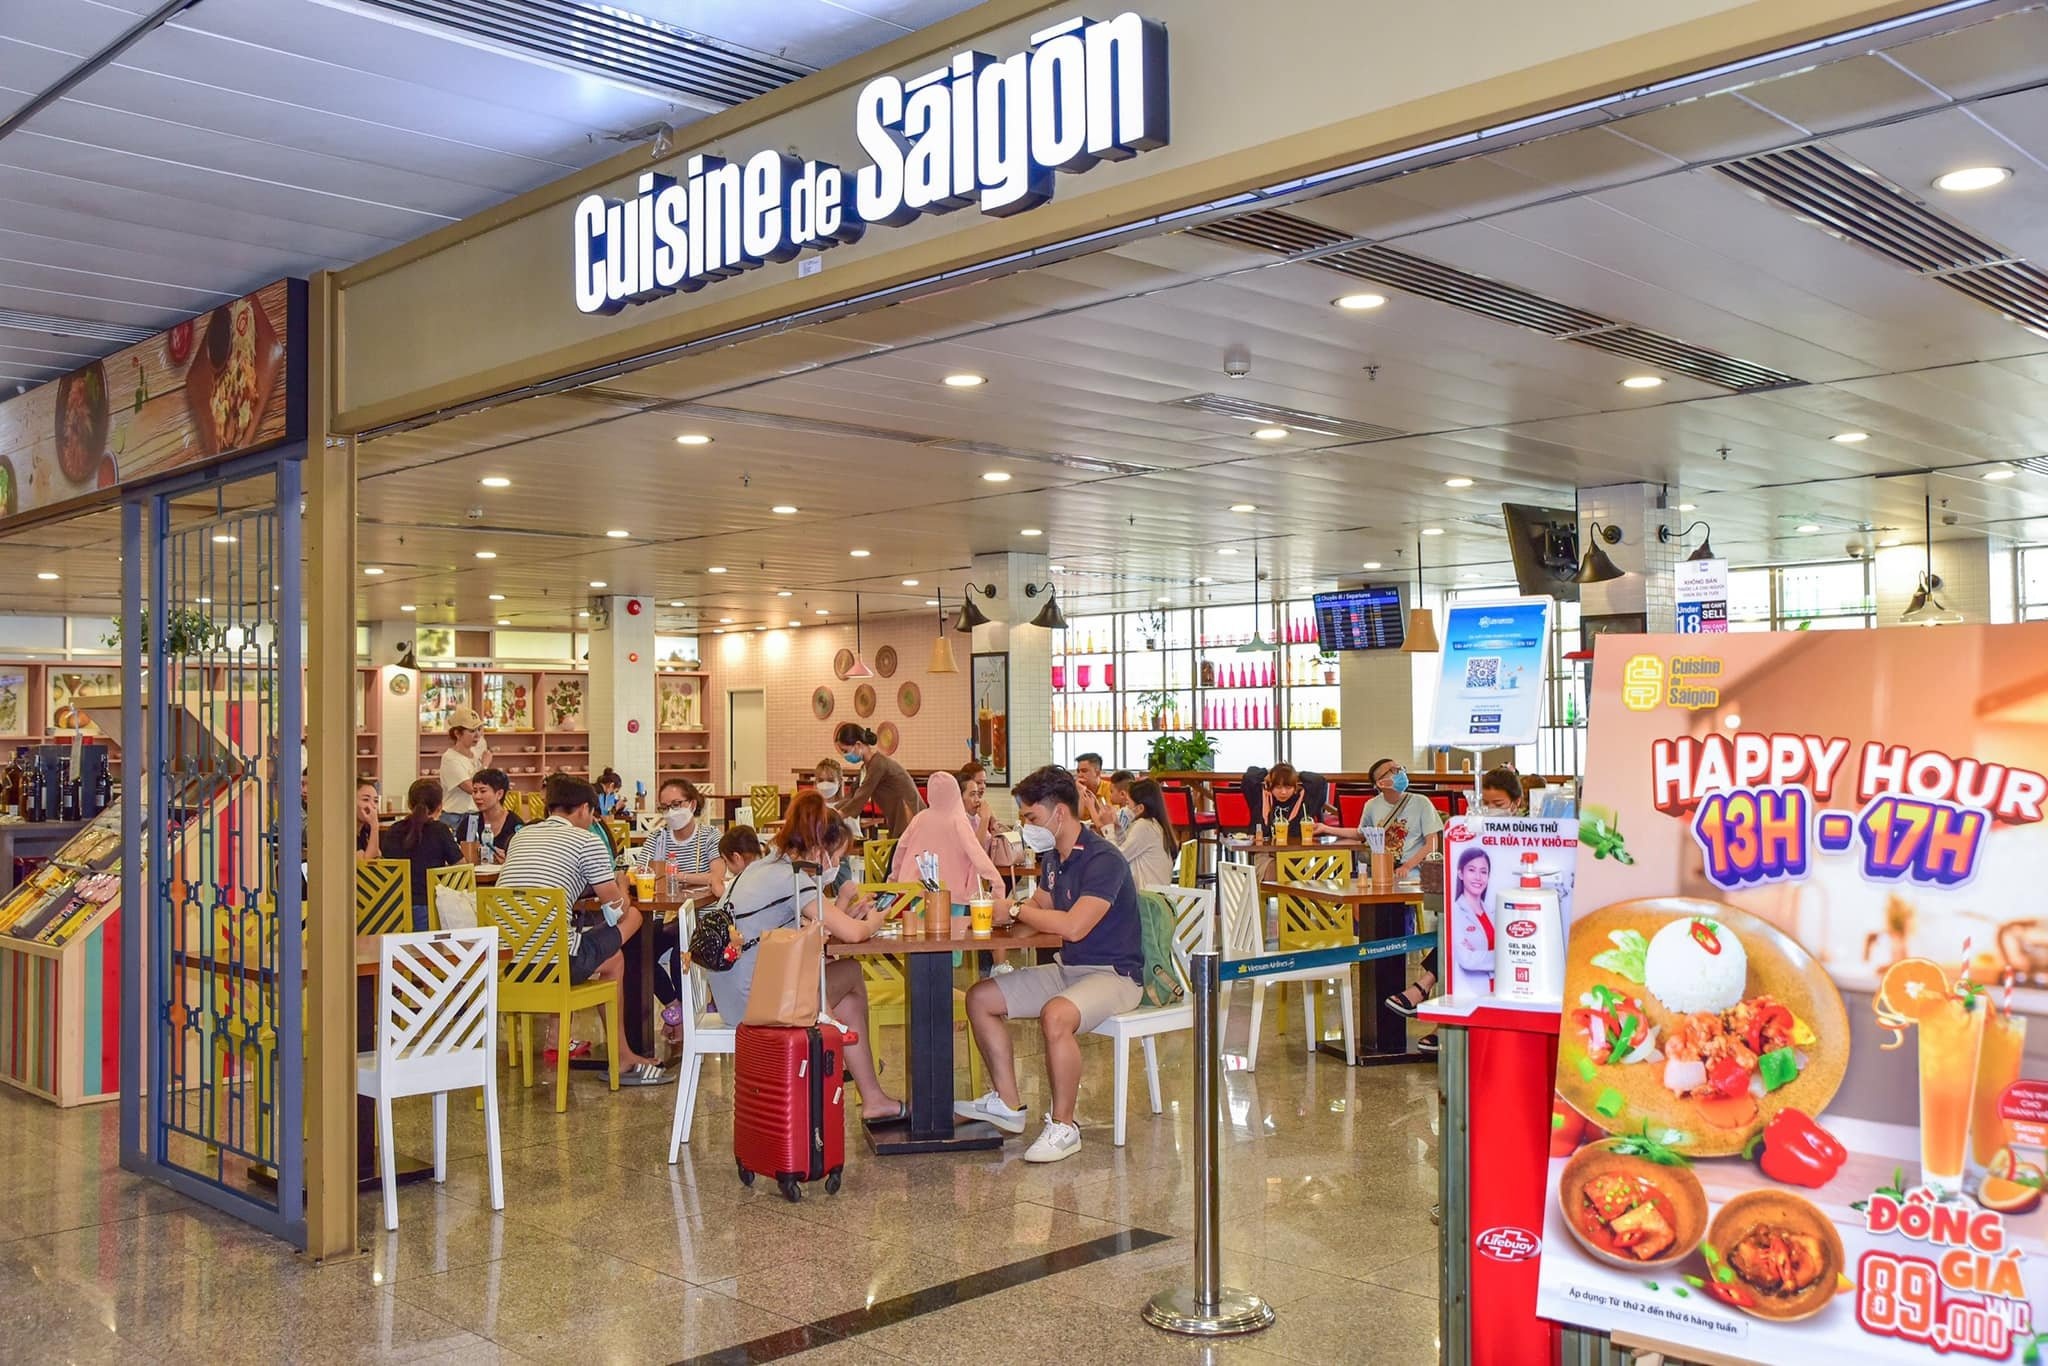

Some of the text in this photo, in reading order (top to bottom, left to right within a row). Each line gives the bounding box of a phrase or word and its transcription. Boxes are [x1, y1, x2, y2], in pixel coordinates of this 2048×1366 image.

[575, 148, 782, 314] Cuisine
[790, 159, 841, 245] de
[1702, 610, 1725, 619] SELL
[1677, 614, 1700, 634] 18
[1671, 658, 1720, 674] Cuisine
[1654, 735, 2046, 819] HAPPY HOUR
[1512, 821, 1538, 833] DÙNG
[1700, 789, 1798, 873] 13H
[1867, 800, 1981, 875] 17H
[1482, 836, 1498, 846] GEL
[1521, 837, 1540, 847] TAY
[1541, 835, 1561, 848] KHÔ
[1868, 1188, 2003, 1252] ĐỒNG
[1484, 1235, 1534, 1252] Lifebuoy
[1941, 1249, 2025, 1298] GIÁ
[1640, 1304, 1646, 1312] 2
